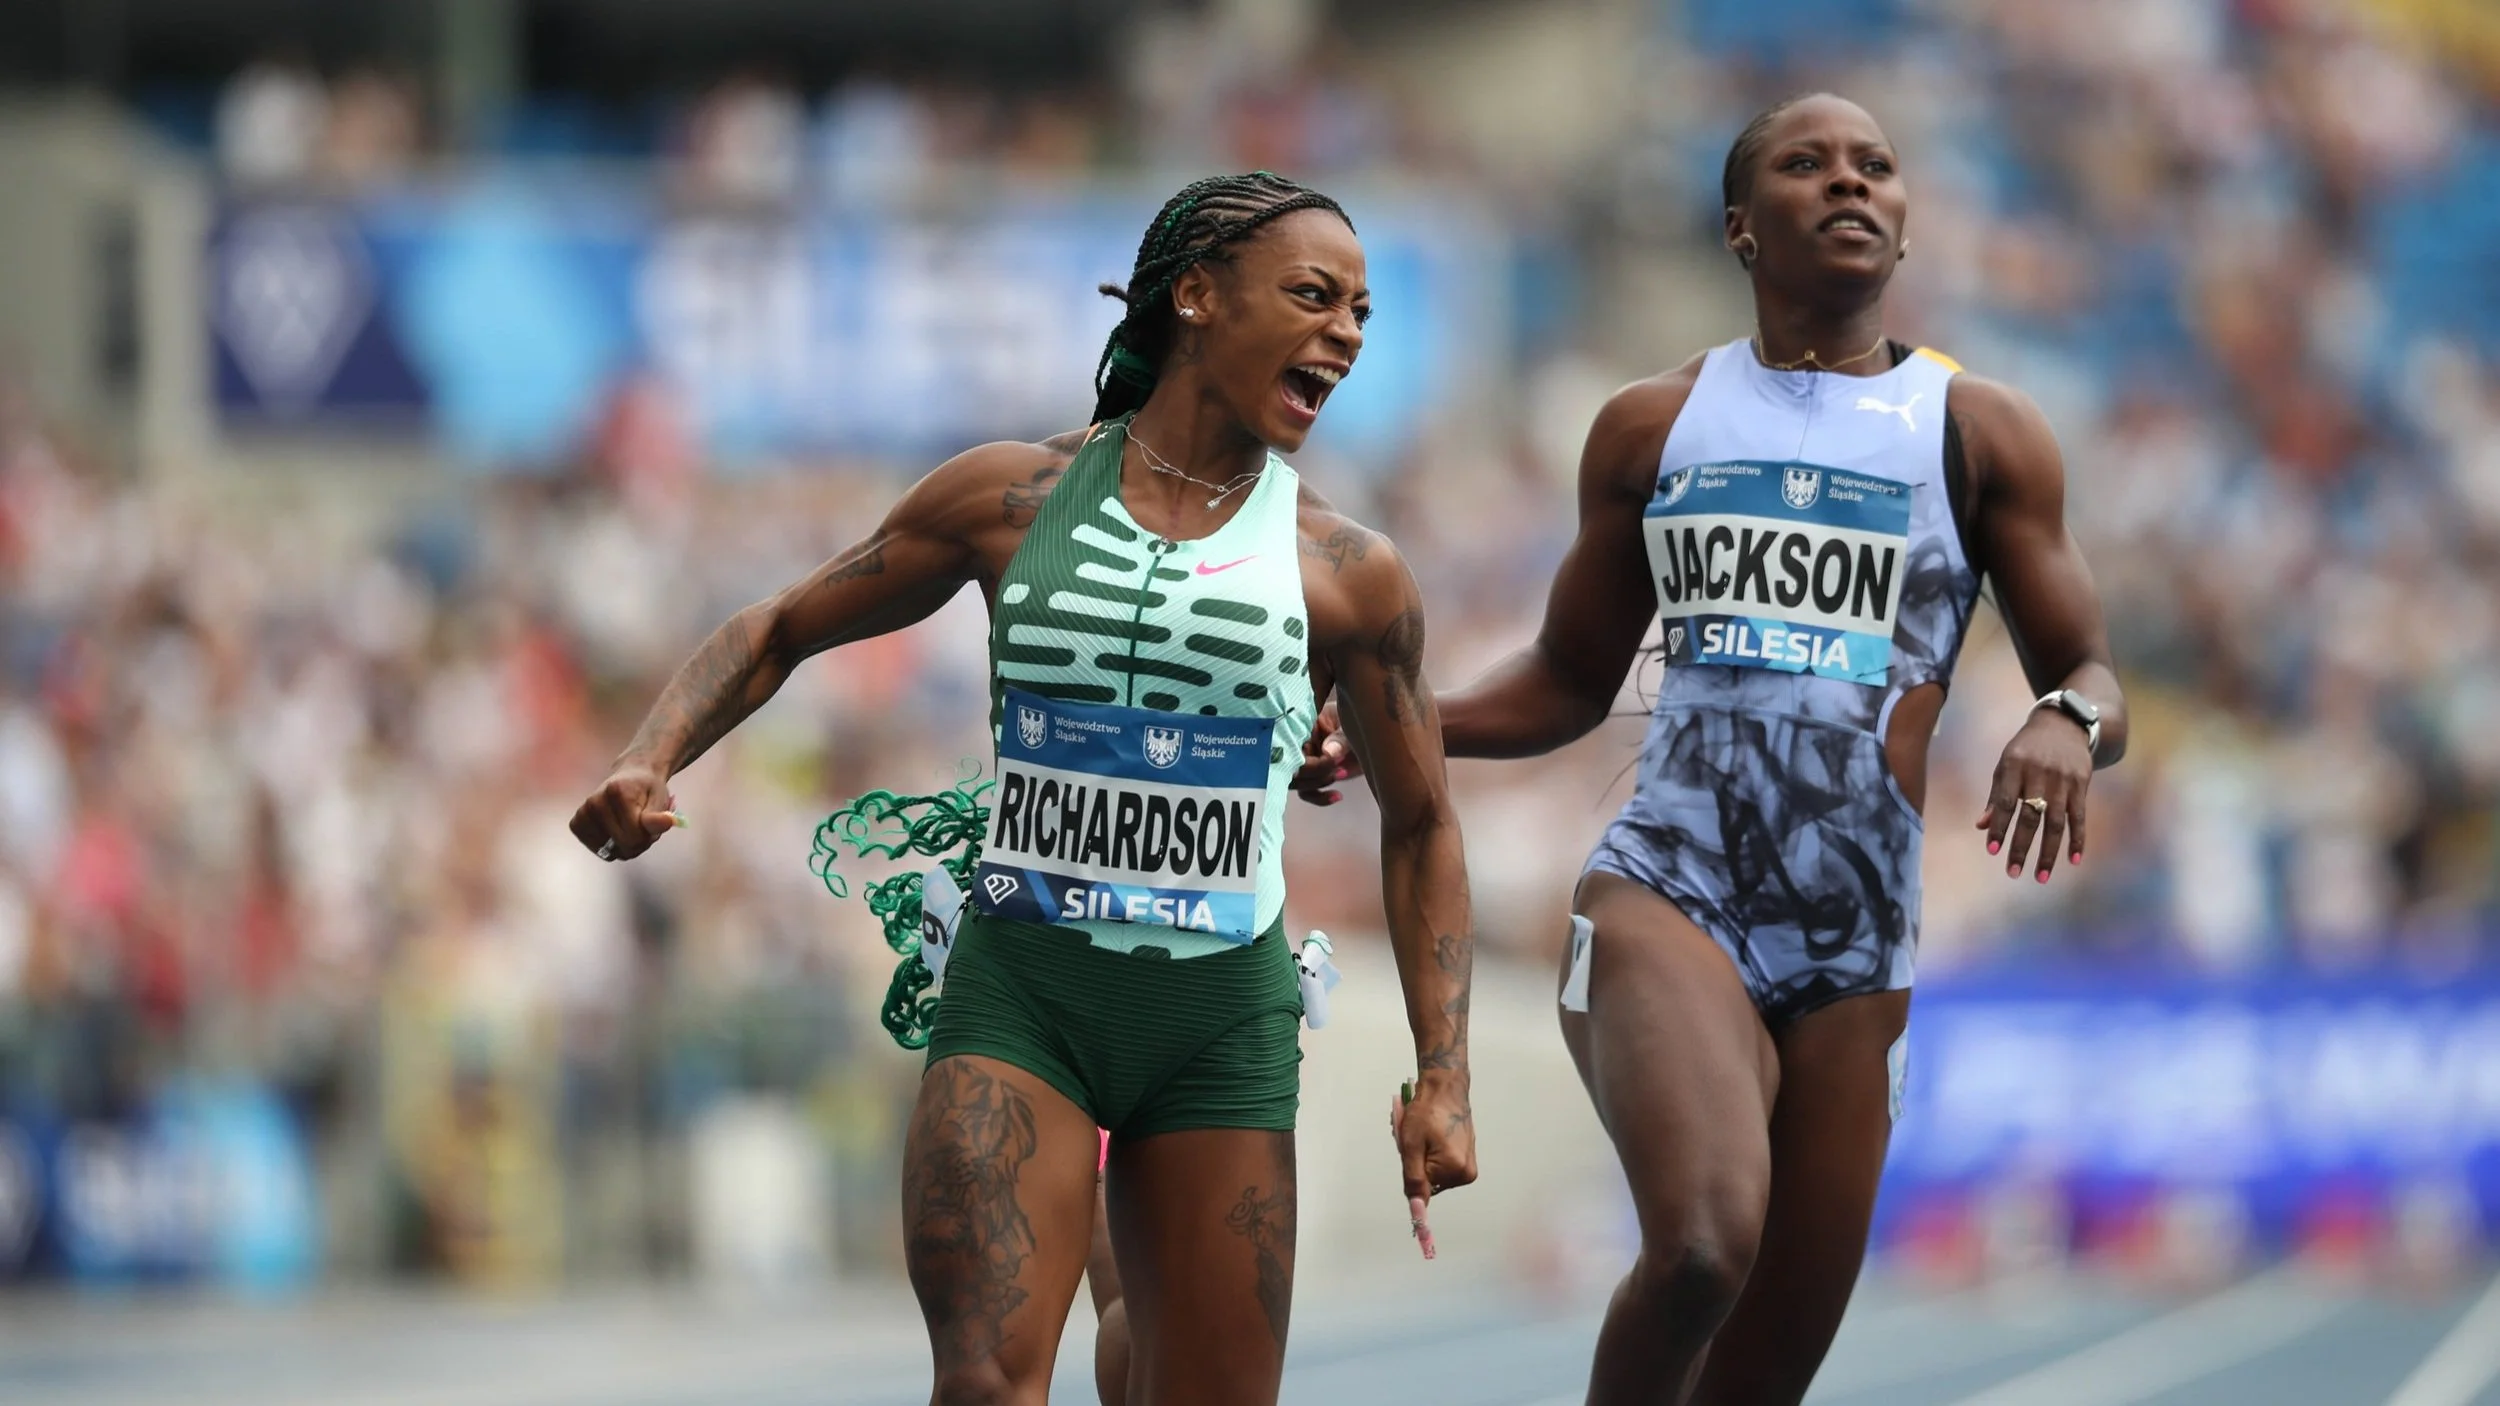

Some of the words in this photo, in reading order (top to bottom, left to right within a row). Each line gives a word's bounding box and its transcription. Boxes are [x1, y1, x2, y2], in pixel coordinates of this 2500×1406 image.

[1700, 464, 1762, 477] Województwo
[1697, 476, 1728, 490] Śląskie
[1830, 474, 1898, 495] Województwo
[1827, 486, 1864, 503] Śląskie
[1661, 525, 1895, 621] JACKSON
[1703, 622, 1849, 671] SILESIA
[1054, 716, 1121, 735] Województwo
[1055, 729, 1087, 744] Śląskie
[1193, 732, 1258, 746] Województwo
[1191, 745, 1226, 760] Śląskie
[994, 771, 1256, 878] RICHARDSON
[1061, 887, 1216, 933] SILESIA
